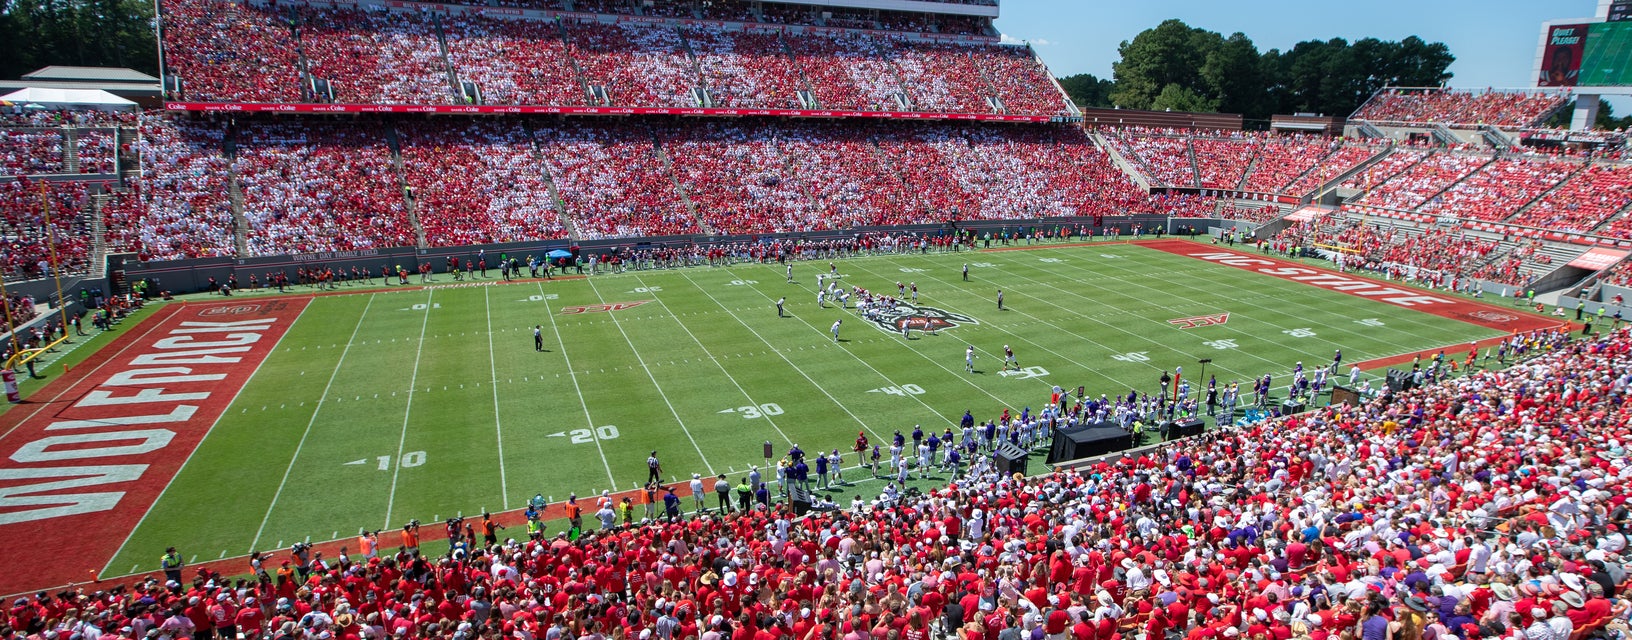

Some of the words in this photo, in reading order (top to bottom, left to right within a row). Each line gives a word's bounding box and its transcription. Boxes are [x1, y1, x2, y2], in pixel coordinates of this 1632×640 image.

[1553, 28, 1575, 37] QUIET
[1200, 190, 1278, 202] WOLFPACK
[1188, 253, 1275, 266] NC
[1258, 267, 1456, 306] STATE
[1166, 312, 1230, 330] ACC
[880, 383, 927, 396] 40
[737, 402, 785, 419] 30
[0, 318, 278, 525] WOLFPACK
[569, 425, 620, 444] 20
[376, 450, 427, 470] 10
[729, 594, 735, 602] 7
